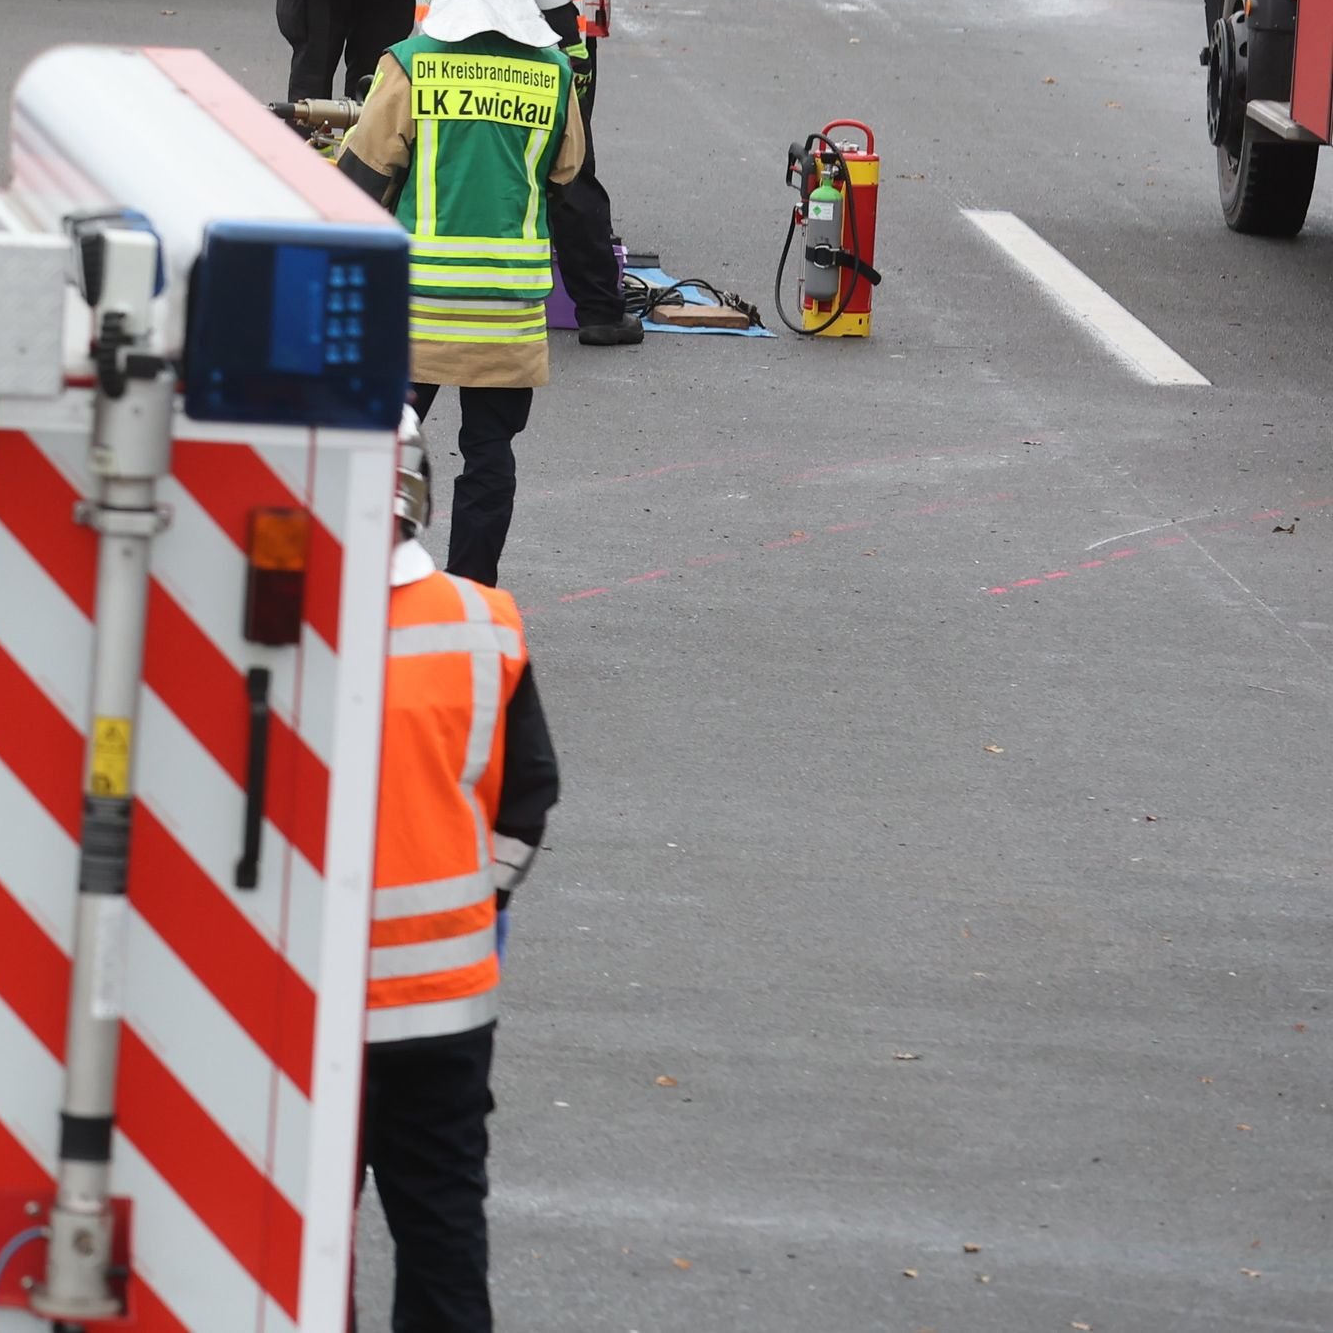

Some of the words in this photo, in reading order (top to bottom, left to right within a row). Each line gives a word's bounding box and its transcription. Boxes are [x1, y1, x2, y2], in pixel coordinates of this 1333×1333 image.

[417, 60, 436, 79] DH
[442, 61, 555, 89] Kreisbrandmeister
[417, 90, 449, 115] LK
[459, 90, 552, 125] Zwickau
